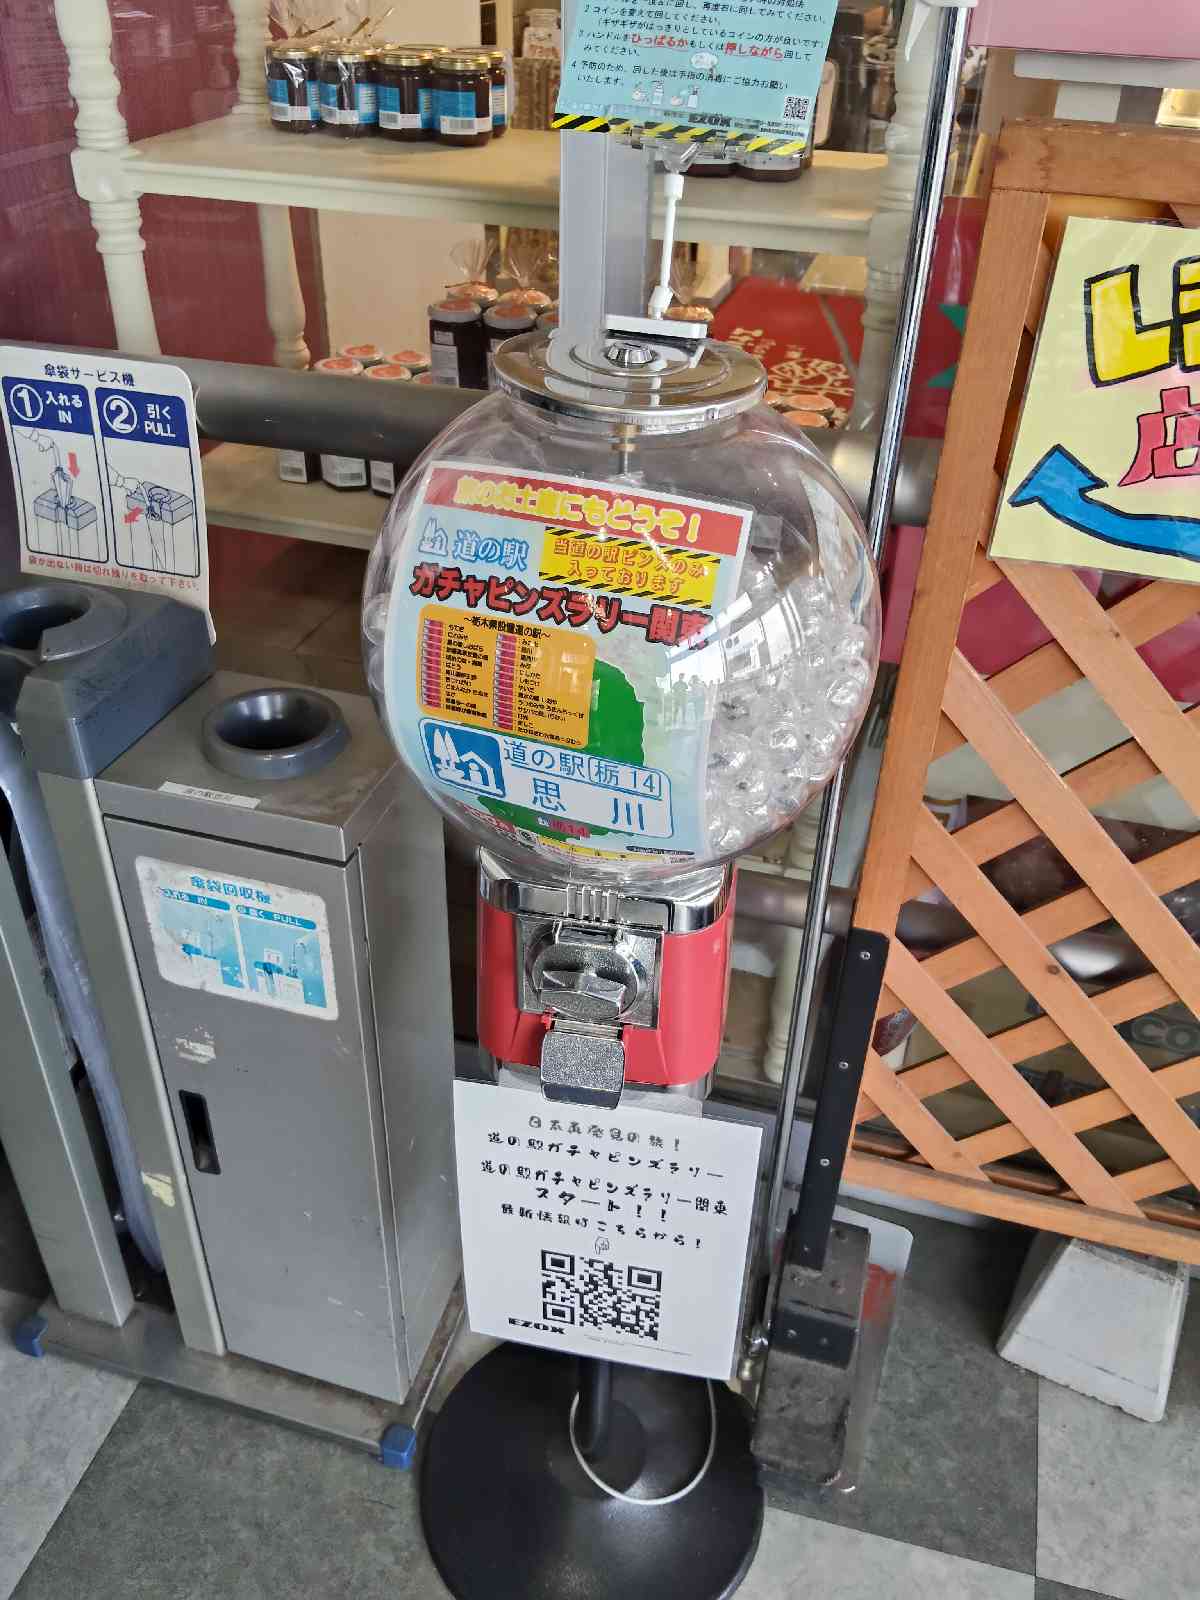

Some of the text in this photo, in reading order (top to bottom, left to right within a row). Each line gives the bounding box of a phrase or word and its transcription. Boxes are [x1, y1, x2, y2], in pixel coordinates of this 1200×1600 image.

[44, 363, 136, 387] 傘袋サービス機
[46, 391, 82, 408] 入れる
[147, 403, 171, 420] 引く
[58, 411, 72, 424] IN
[144, 420, 176, 438] PULL
[452, 528, 530, 572] 道の駅
[568, 559, 683, 595] 入っております
[503, 738, 586, 779] 道の駅
[532, 777, 644, 831] 思川
[273, 913, 304, 926] PULL
[488, 1132, 724, 1178] 道の駅ガチャピンズラリー
[481, 1160, 728, 1216] 道の駅ガチャピンズラリー関東
